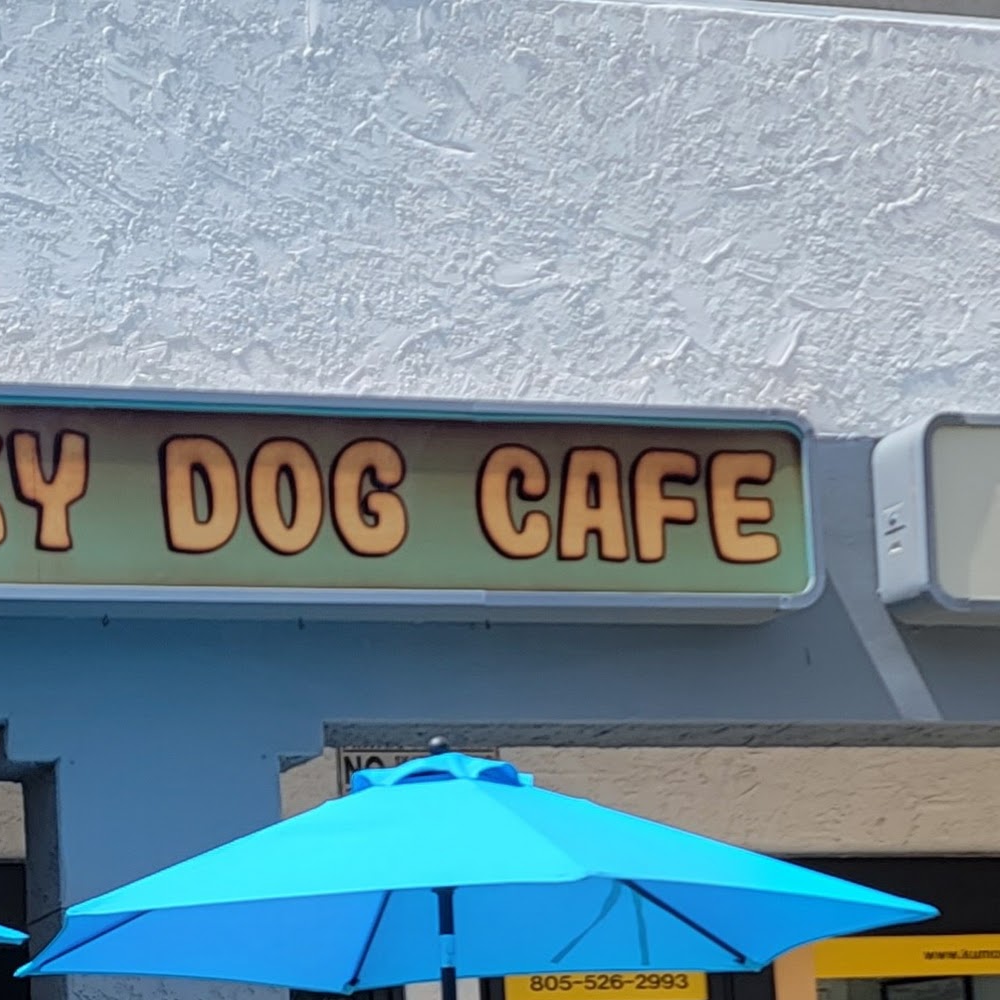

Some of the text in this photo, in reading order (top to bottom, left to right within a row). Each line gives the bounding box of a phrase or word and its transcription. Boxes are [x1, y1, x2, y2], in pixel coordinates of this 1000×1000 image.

[157, 433, 409, 558] DOG
[475, 443, 780, 564] CAFE
[529, 973, 690, 991] 805-526-2993
